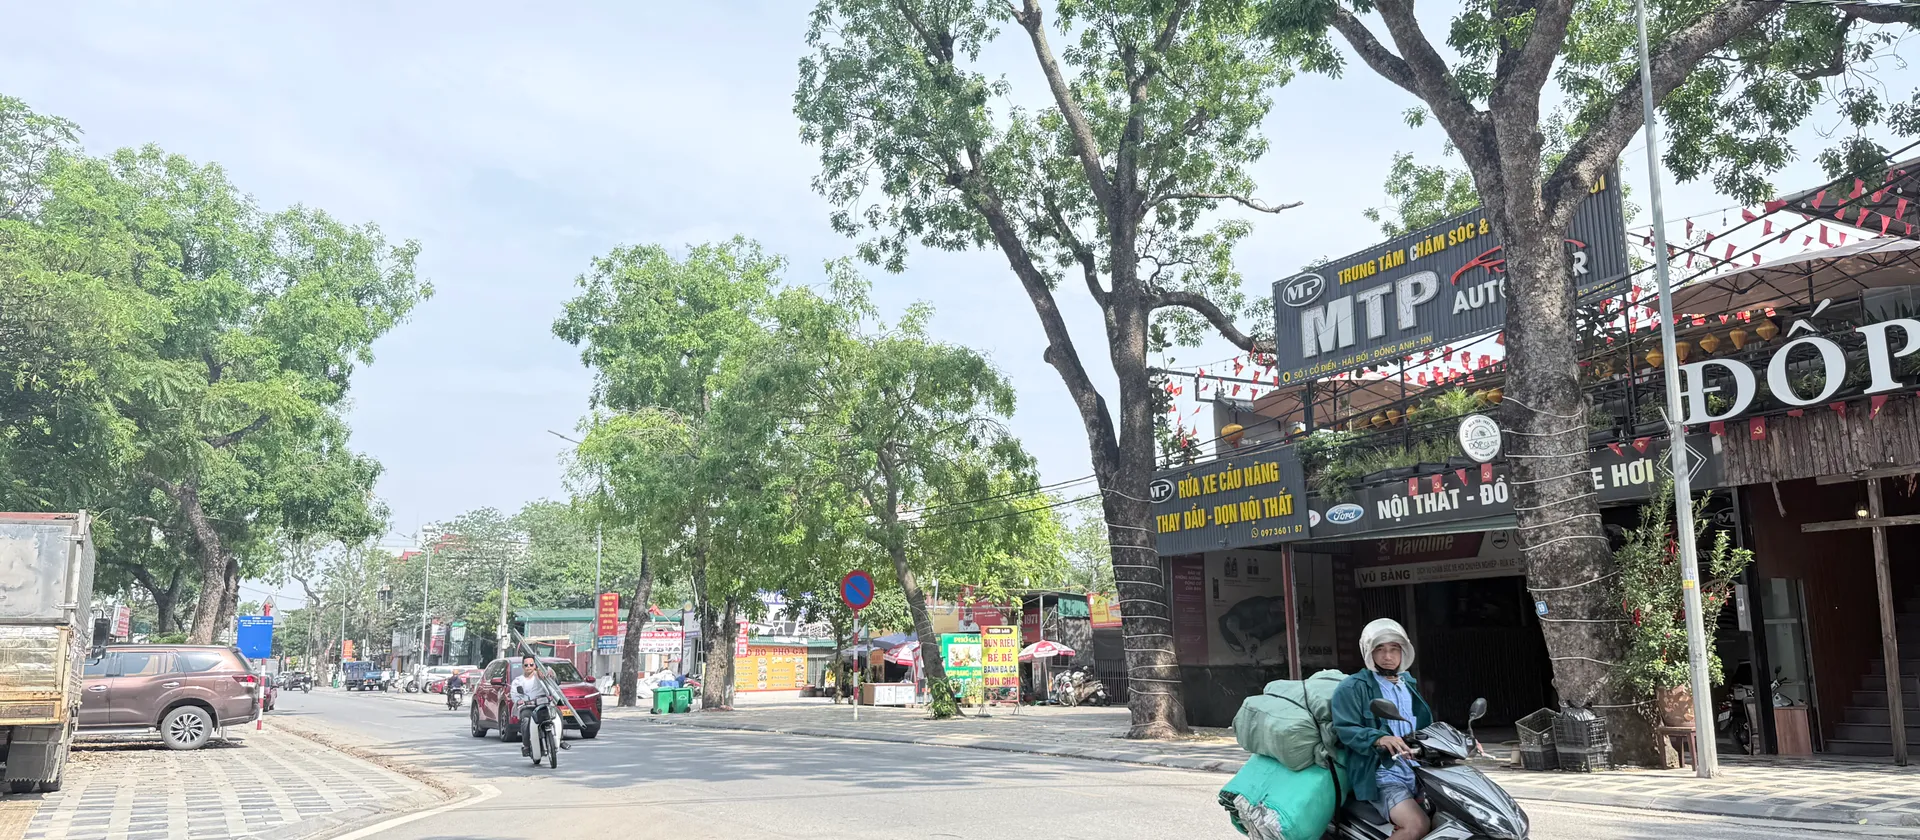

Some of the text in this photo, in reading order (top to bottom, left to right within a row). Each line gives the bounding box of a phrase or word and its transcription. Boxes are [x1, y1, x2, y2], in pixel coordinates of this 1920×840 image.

[1338, 217, 1489, 285] TRUNG TÂM CHĂM SÓC &
[1287, 278, 1321, 302] MTP
[1301, 270, 1440, 358] MTP
[1374, 346, 1396, 358] ĐÔNG
[1398, 341, 1415, 352] ANH
[1420, 335, 1432, 345] HN
[1178, 471, 1200, 499] RỬA
[1202, 473, 1218, 494] XE
[1244, 460, 1279, 487] NÂNG
[1377, 494, 1410, 522] NỘI
[1412, 482, 1460, 515] THẤT
[1479, 474, 1509, 506] ĐỒ
[1610, 457, 1655, 488] HƠI
[1156, 512, 1181, 534] THAY
[1213, 503, 1238, 529] DỌN
[1240, 495, 1262, 525] NỘI
[1262, 486, 1294, 518] THẤT
[1333, 508, 1355, 521] Ford
[1394, 534, 1454, 555] Havoline
[1024, 613, 1038, 625] 1971
